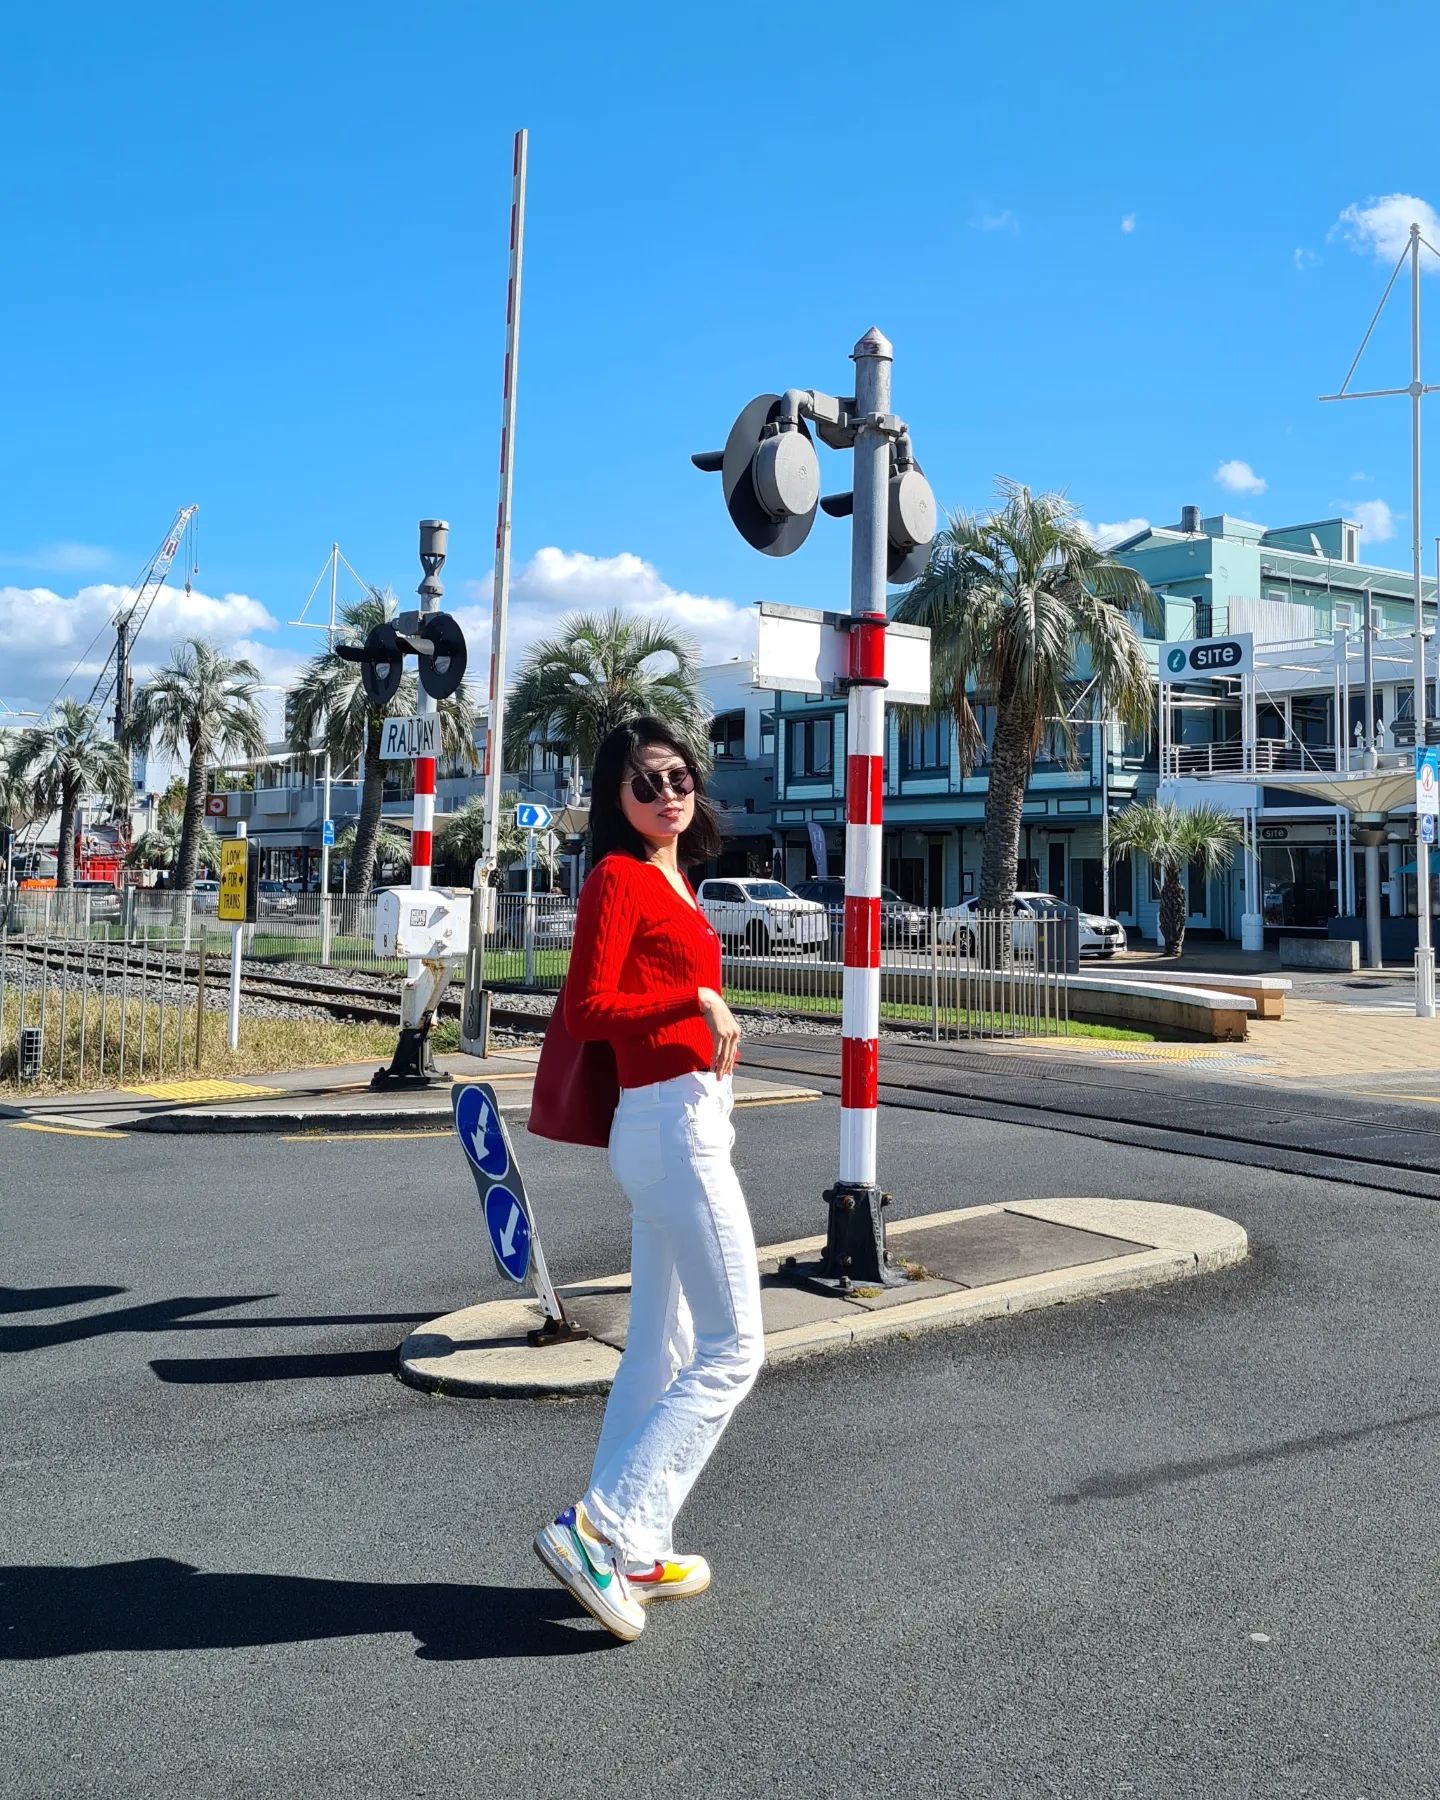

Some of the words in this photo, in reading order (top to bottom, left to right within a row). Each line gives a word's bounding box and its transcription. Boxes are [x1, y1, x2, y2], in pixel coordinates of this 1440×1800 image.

[226, 850, 241, 866] LOOK
[227, 872, 238, 888] FOR
[223, 894, 241, 910] TRAINS
